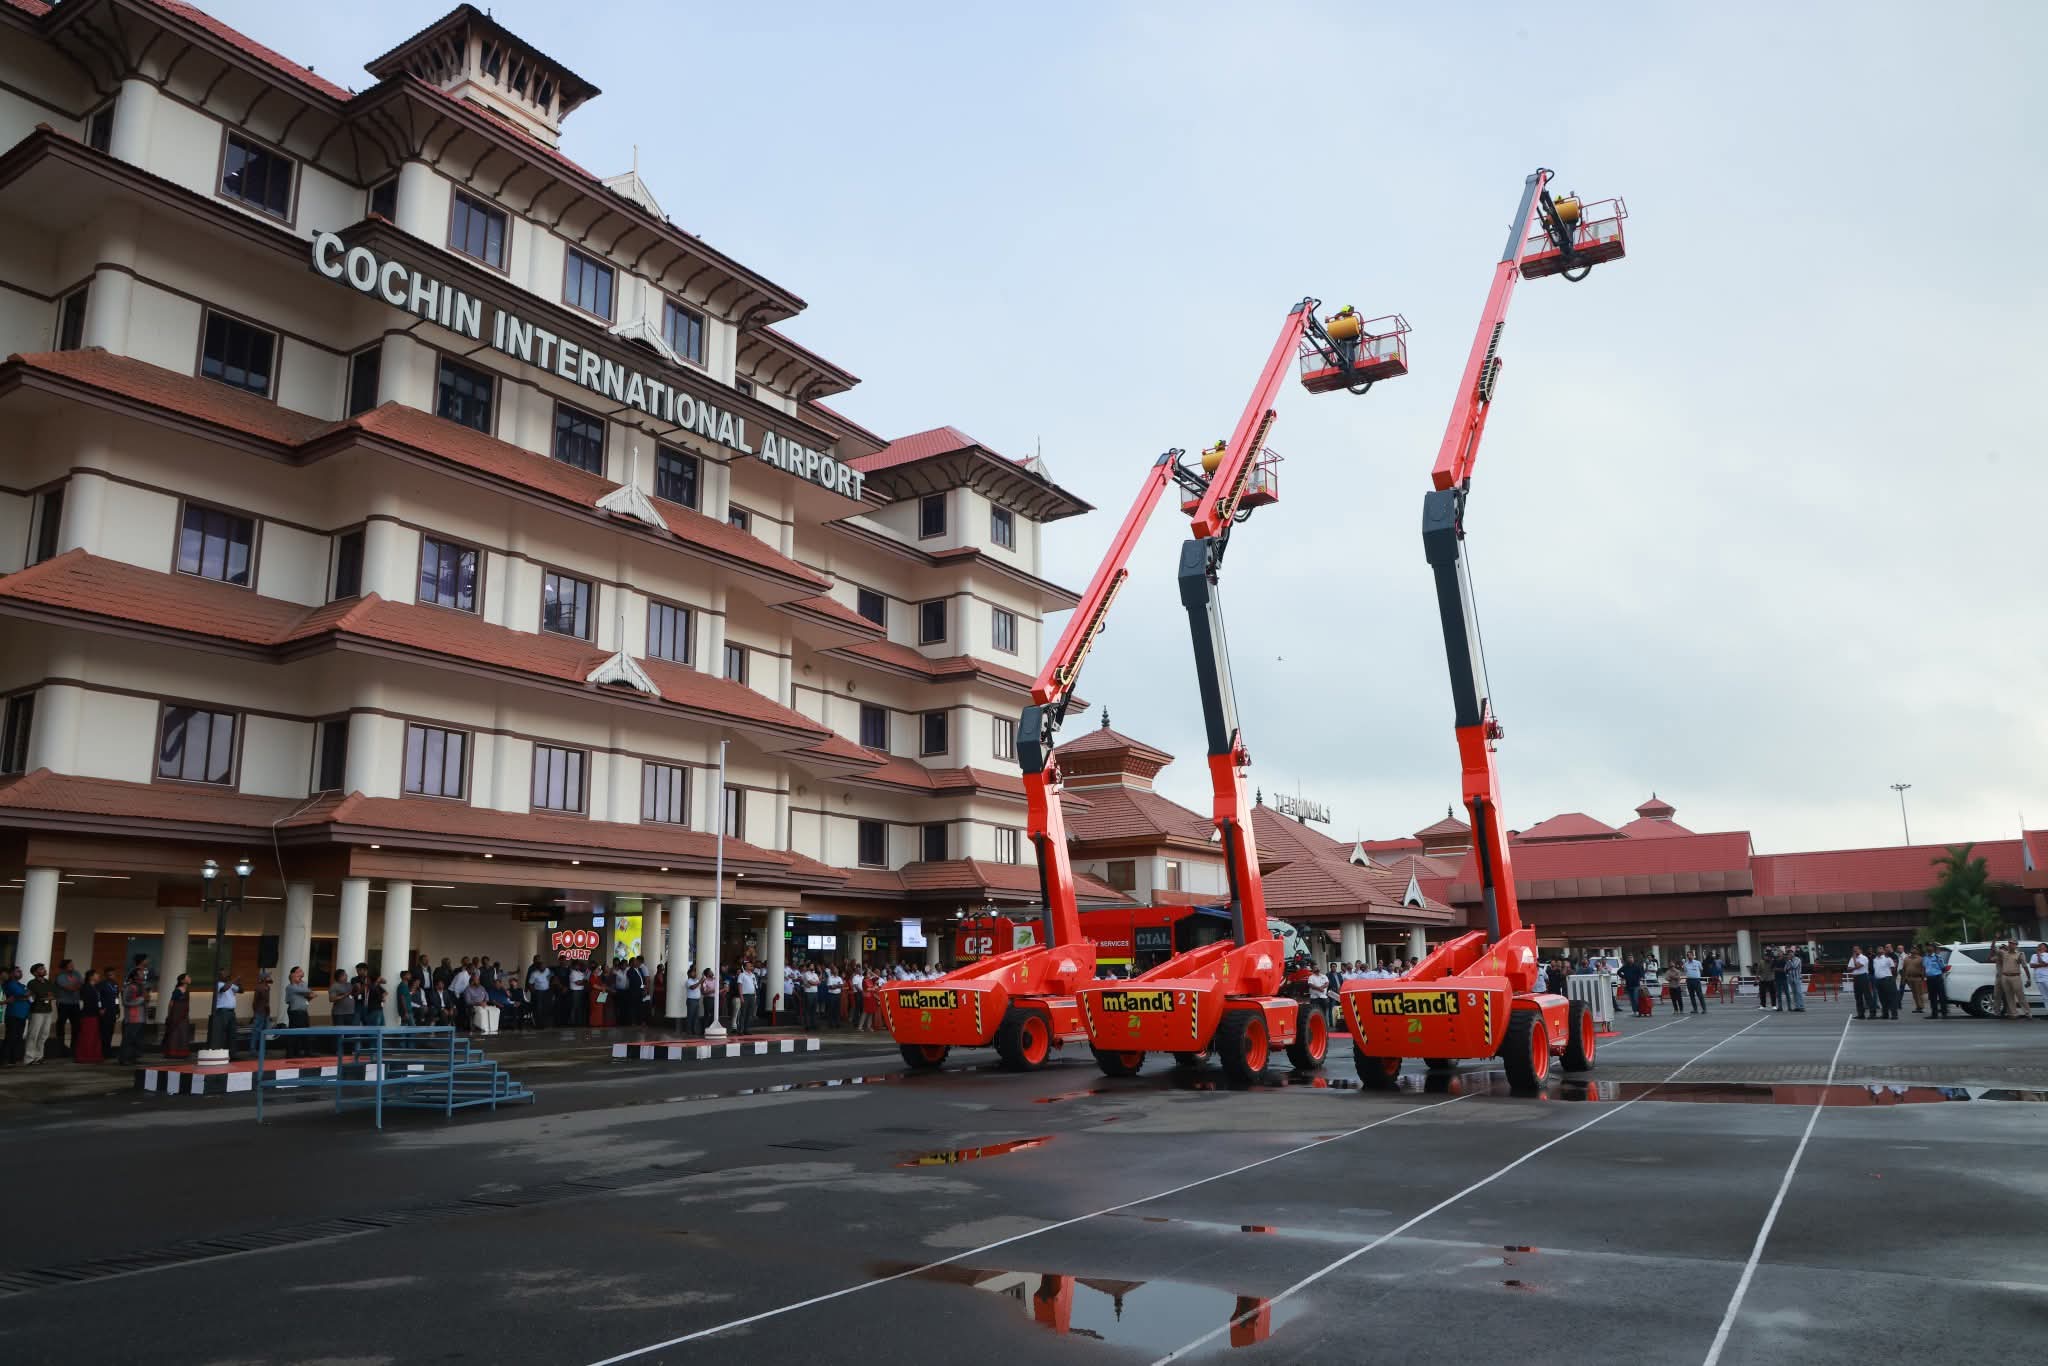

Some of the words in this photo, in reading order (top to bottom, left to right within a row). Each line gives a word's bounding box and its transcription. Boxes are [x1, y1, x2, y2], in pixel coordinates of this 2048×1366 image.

[311, 231, 482, 339] COCHIN
[493, 309, 753, 455] INTERNATIONAL
[759, 430, 866, 502] AIRPORT
[552, 930, 599, 950] FOOD
[900, 990, 957, 1008] mtandt
[961, 993, 967, 1005] 1
[1103, 991, 1173, 1011] mtandt
[1178, 992, 1187, 1005] 2
[1373, 992, 1458, 1014] mtandt
[1467, 993, 1477, 1006] 3
